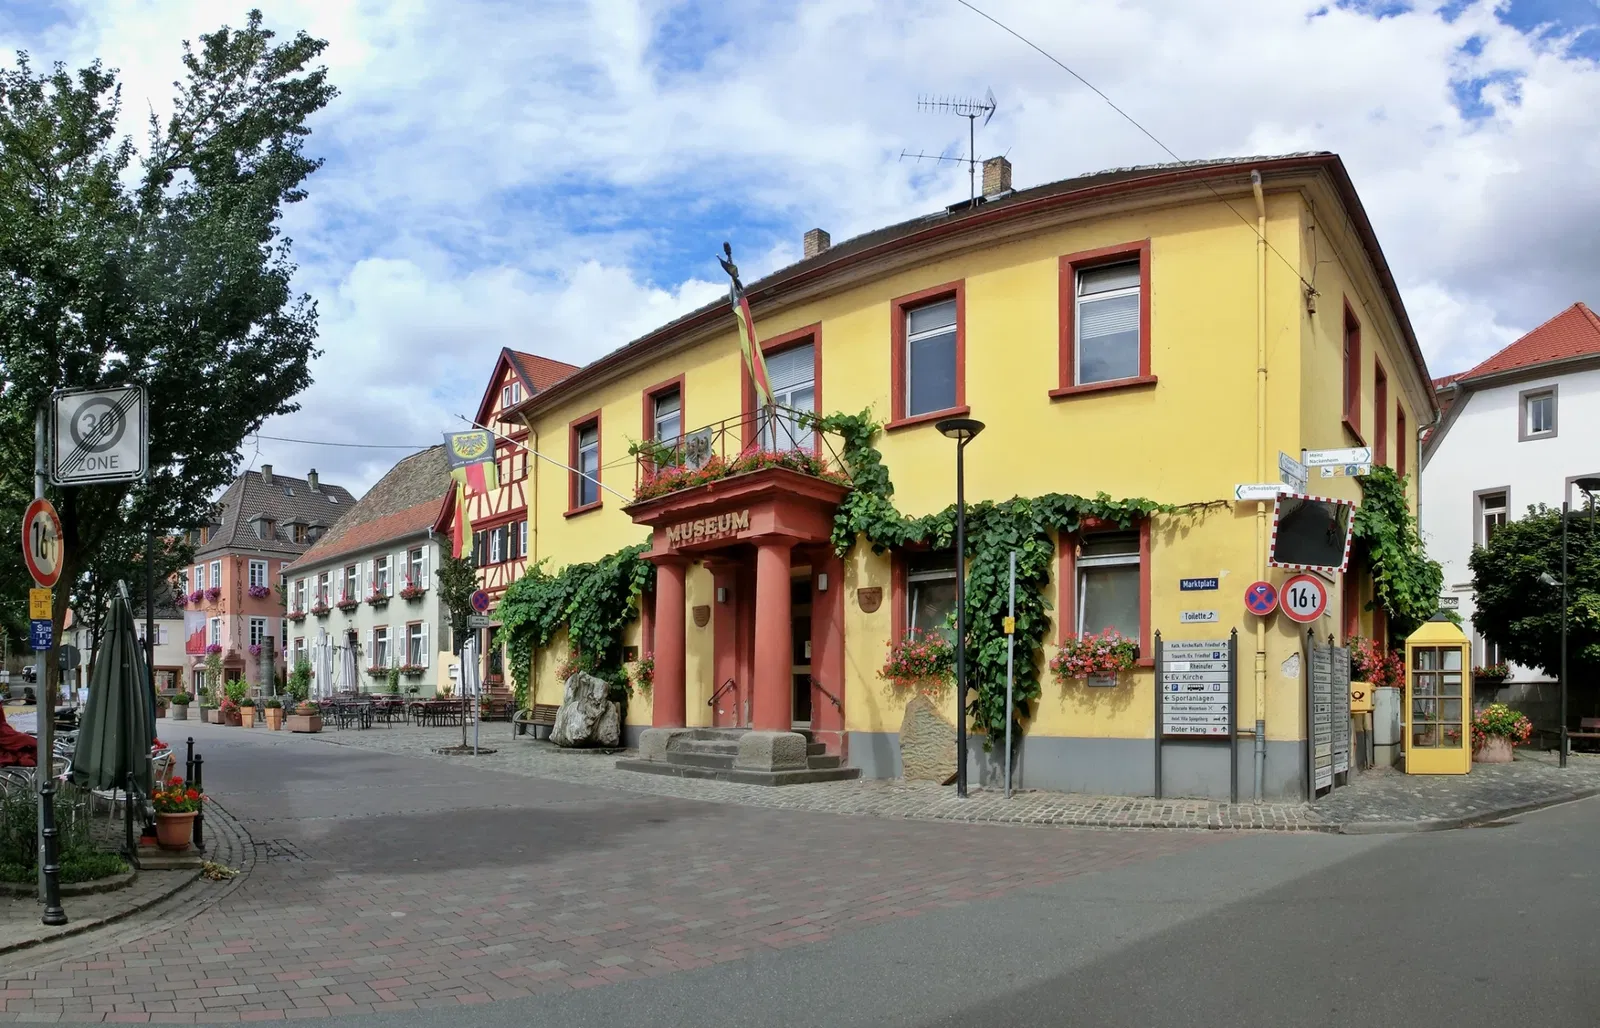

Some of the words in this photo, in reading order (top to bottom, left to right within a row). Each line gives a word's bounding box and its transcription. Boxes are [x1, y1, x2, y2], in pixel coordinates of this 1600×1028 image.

[82, 411, 114, 437] 30
[77, 455, 119, 472] ZONE
[666, 510, 750, 542] MUSEUM
[33, 521, 48, 560] 16
[1182, 580, 1216, 589] Marktplatz
[1290, 588, 1307, 608] 16
[1311, 594, 1316, 608] t
